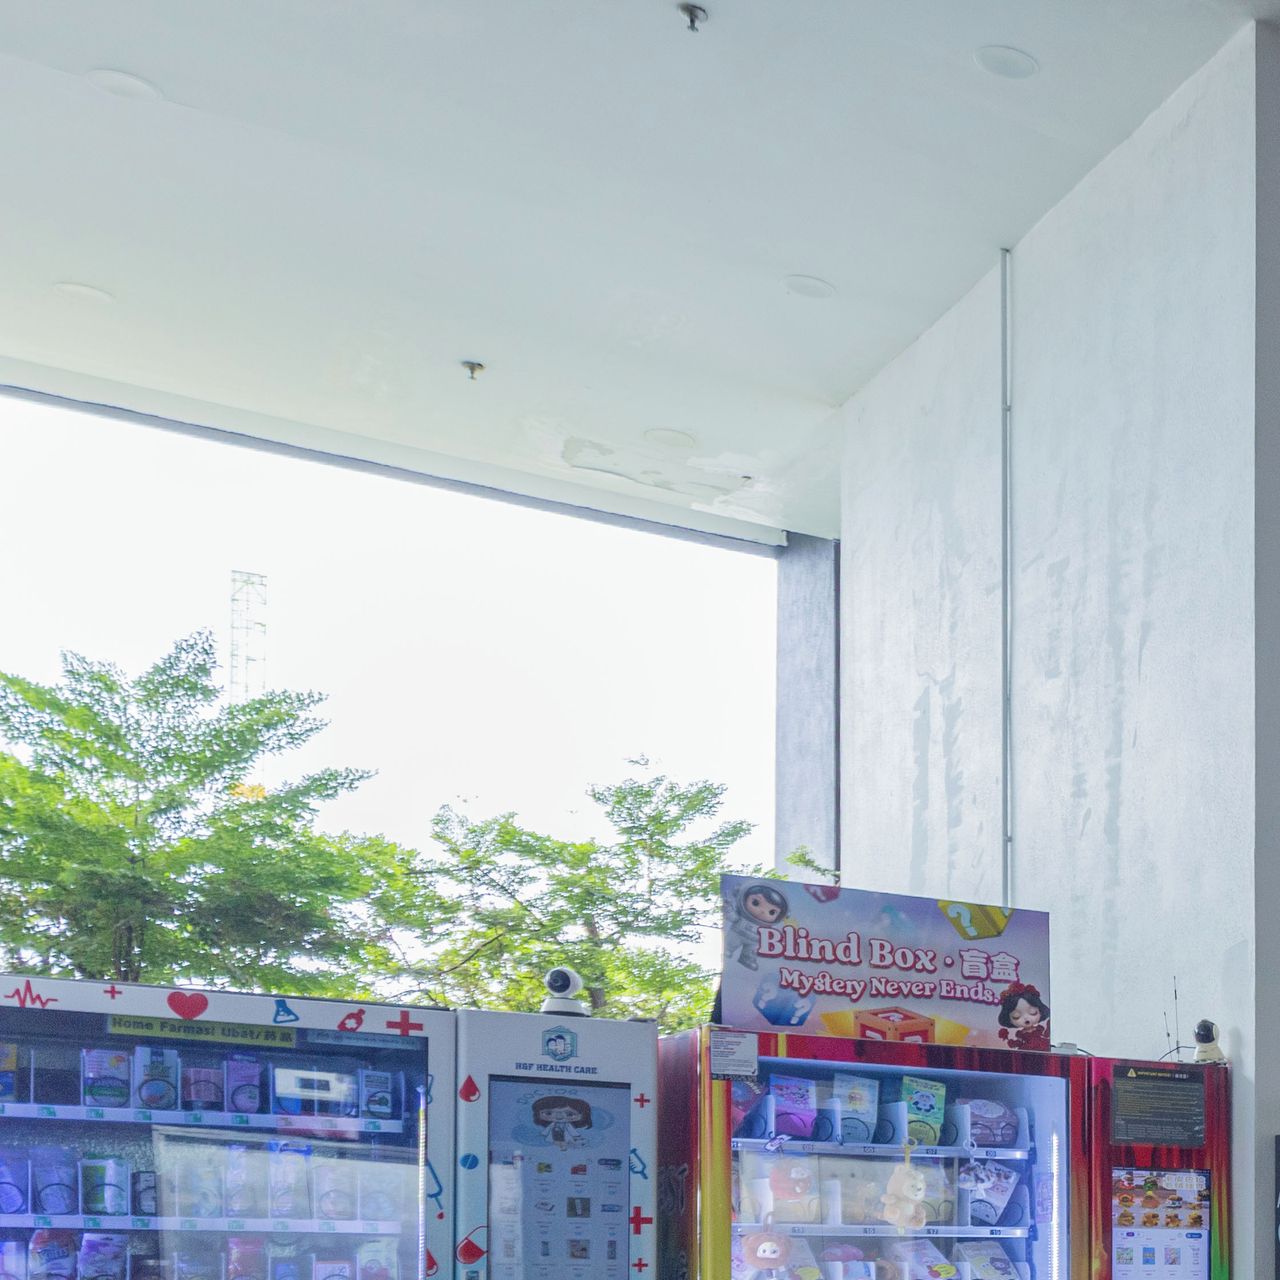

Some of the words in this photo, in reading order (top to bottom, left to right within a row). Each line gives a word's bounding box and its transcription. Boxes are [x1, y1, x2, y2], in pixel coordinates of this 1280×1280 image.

[757, 926, 860, 965] Blind
[870, 939, 938, 972] Box
[960, 949, 1020, 982] 盲盒
[780, 967, 865, 1002] Mystery
[871, 977, 935, 998] Never
[112, 1017, 154, 1031] Home
[536, 1063, 572, 1073] HEALTH
[574, 1066, 598, 1075] CARE
